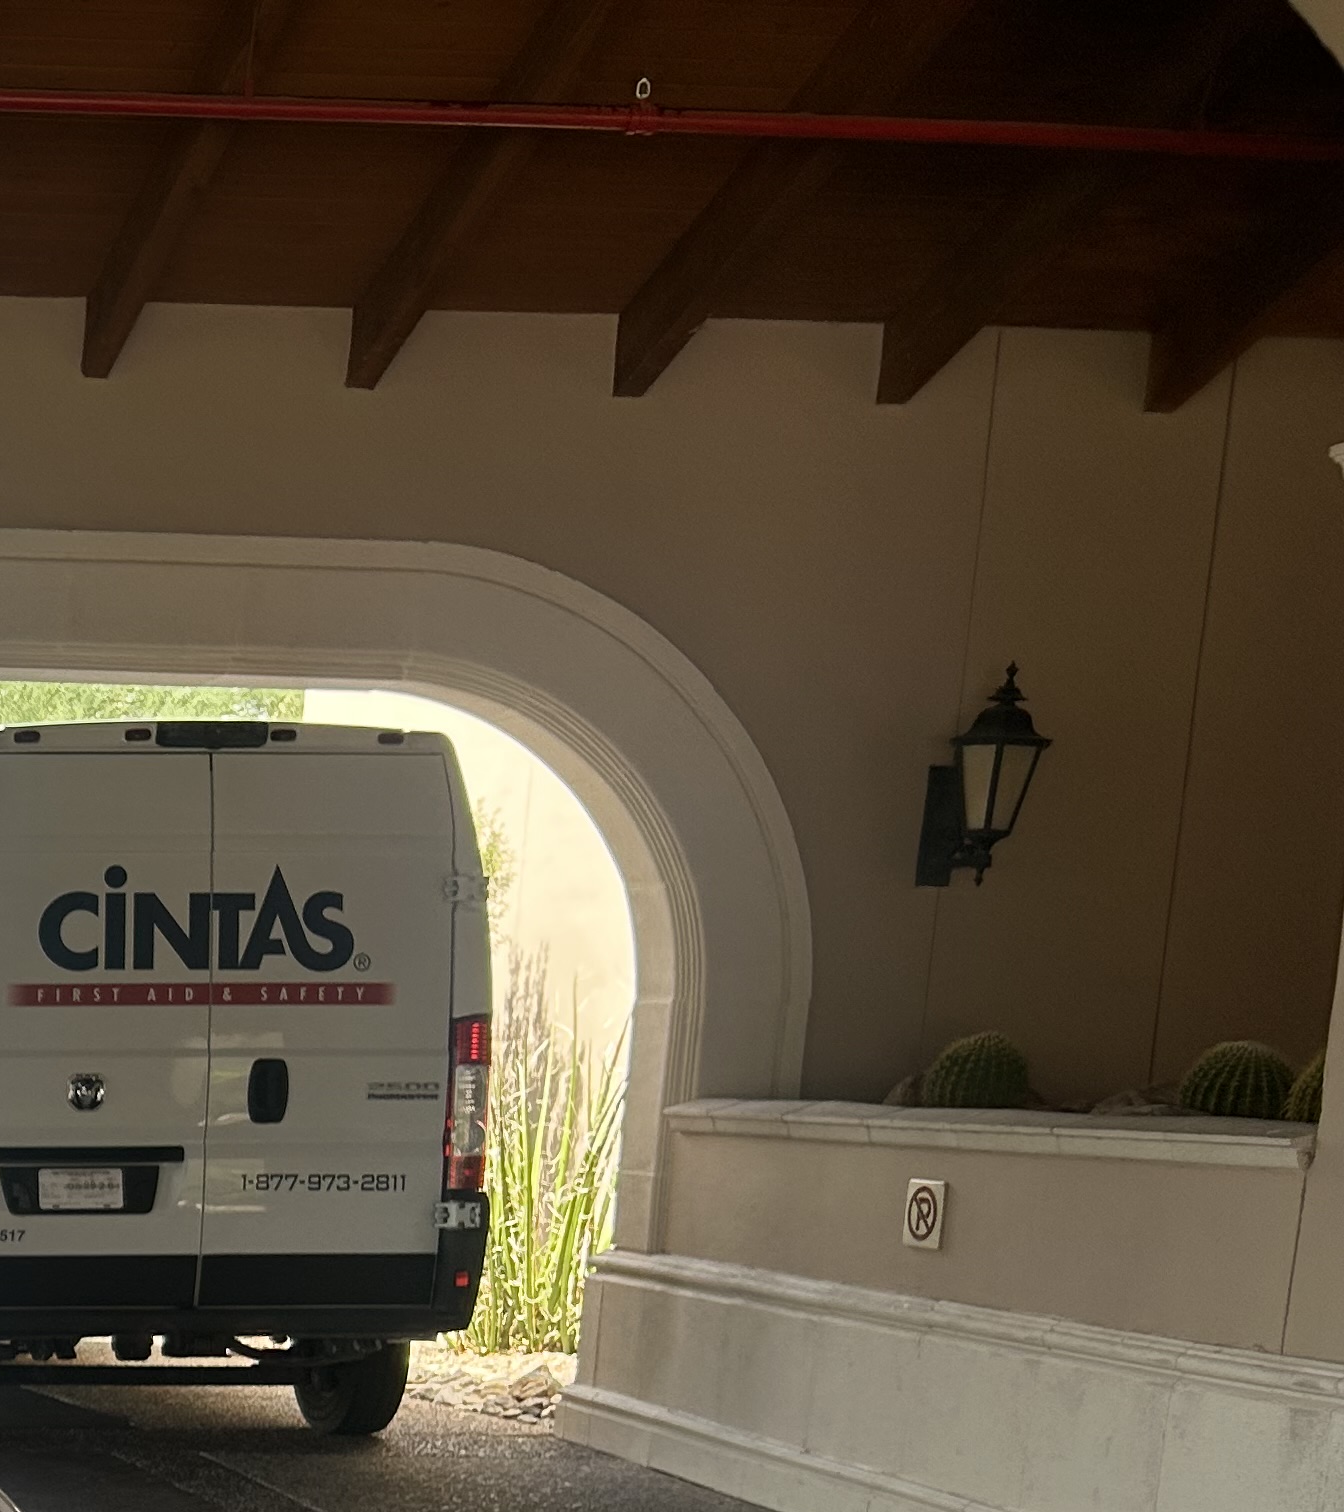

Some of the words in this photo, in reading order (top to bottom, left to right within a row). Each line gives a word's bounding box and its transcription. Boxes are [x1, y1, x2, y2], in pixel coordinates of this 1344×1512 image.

[37, 988, 120, 1002] FIRST
[147, 987, 194, 1002] AID
[222, 987, 232, 1002] &
[260, 986, 364, 1002] SAFETY
[241, 1174, 407, 1191] 1-877-973-2811
